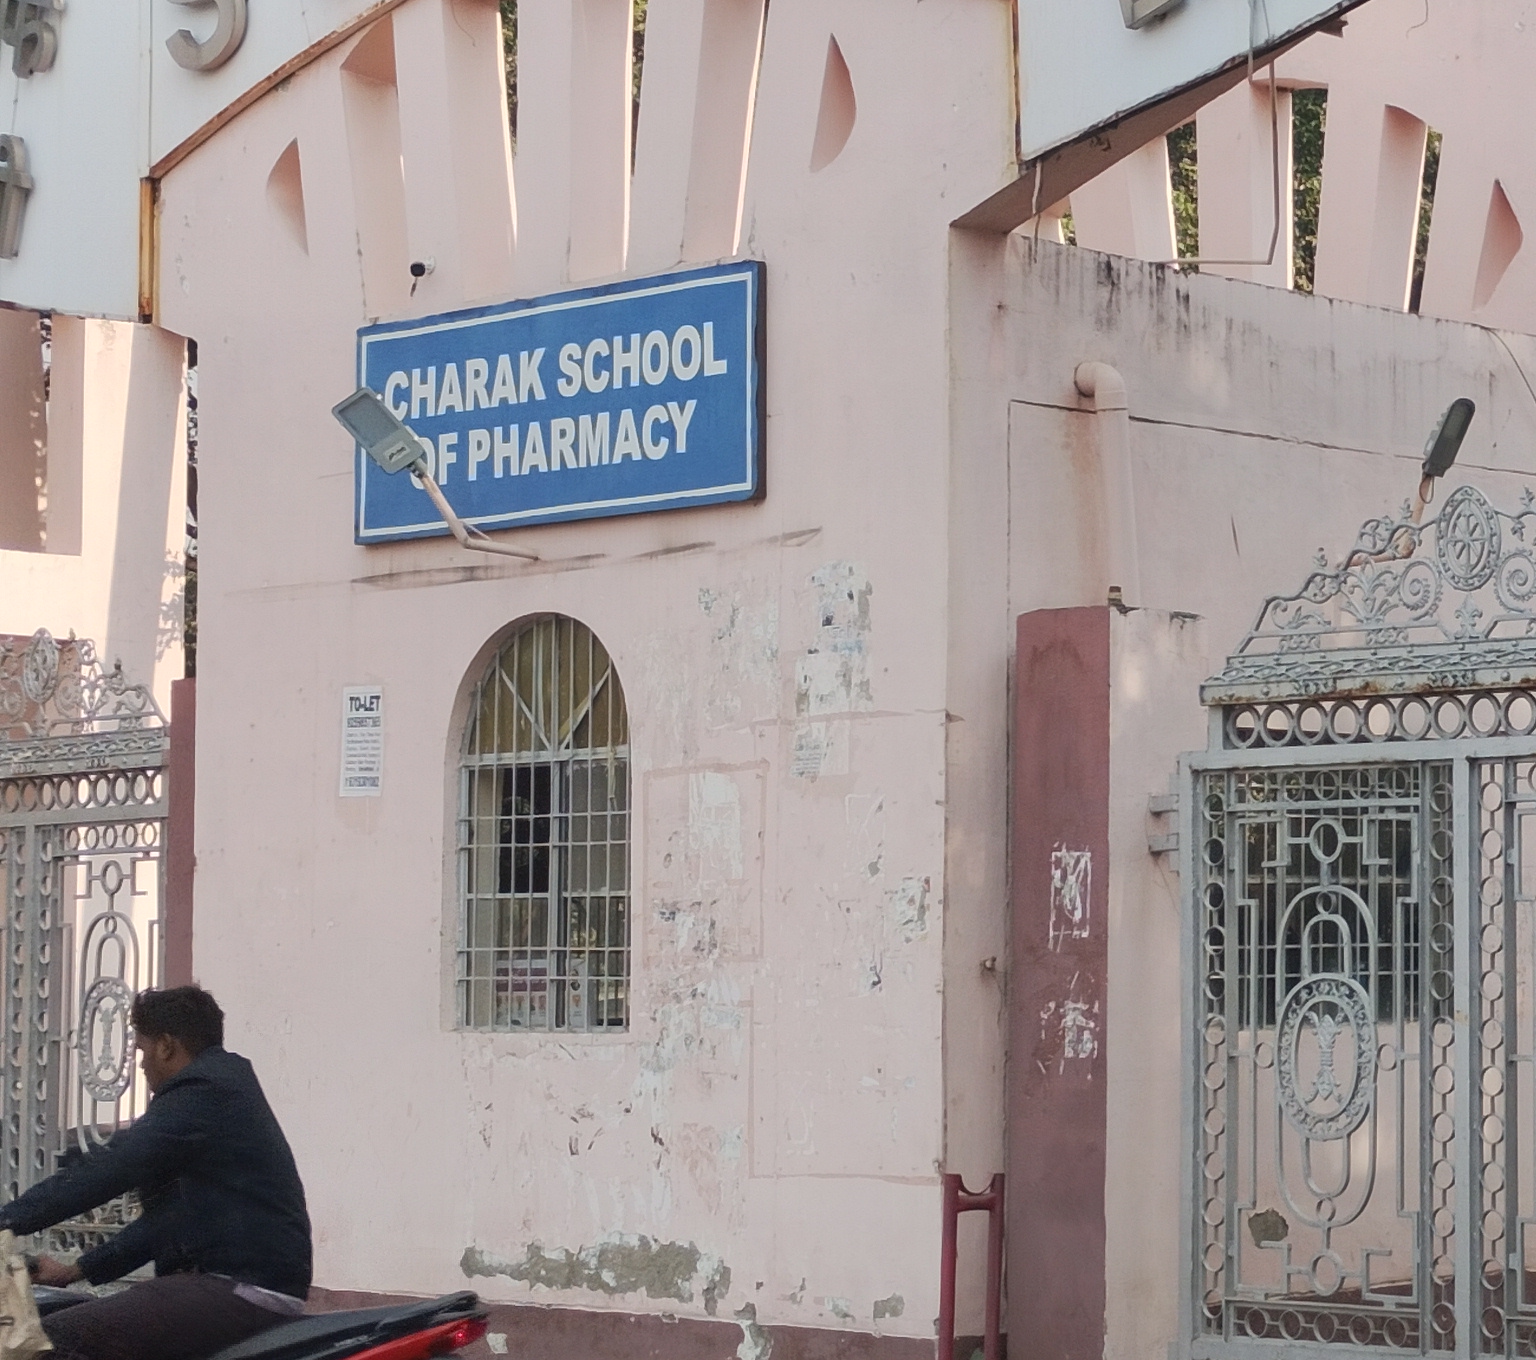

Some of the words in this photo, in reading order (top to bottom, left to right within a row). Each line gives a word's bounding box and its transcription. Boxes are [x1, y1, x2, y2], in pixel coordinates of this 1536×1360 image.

[384, 347, 546, 420] CHARAK
[556, 321, 728, 398] SCHOOL
[467, 399, 698, 482] PHARMACY
[349, 695, 381, 713] TO-LET
